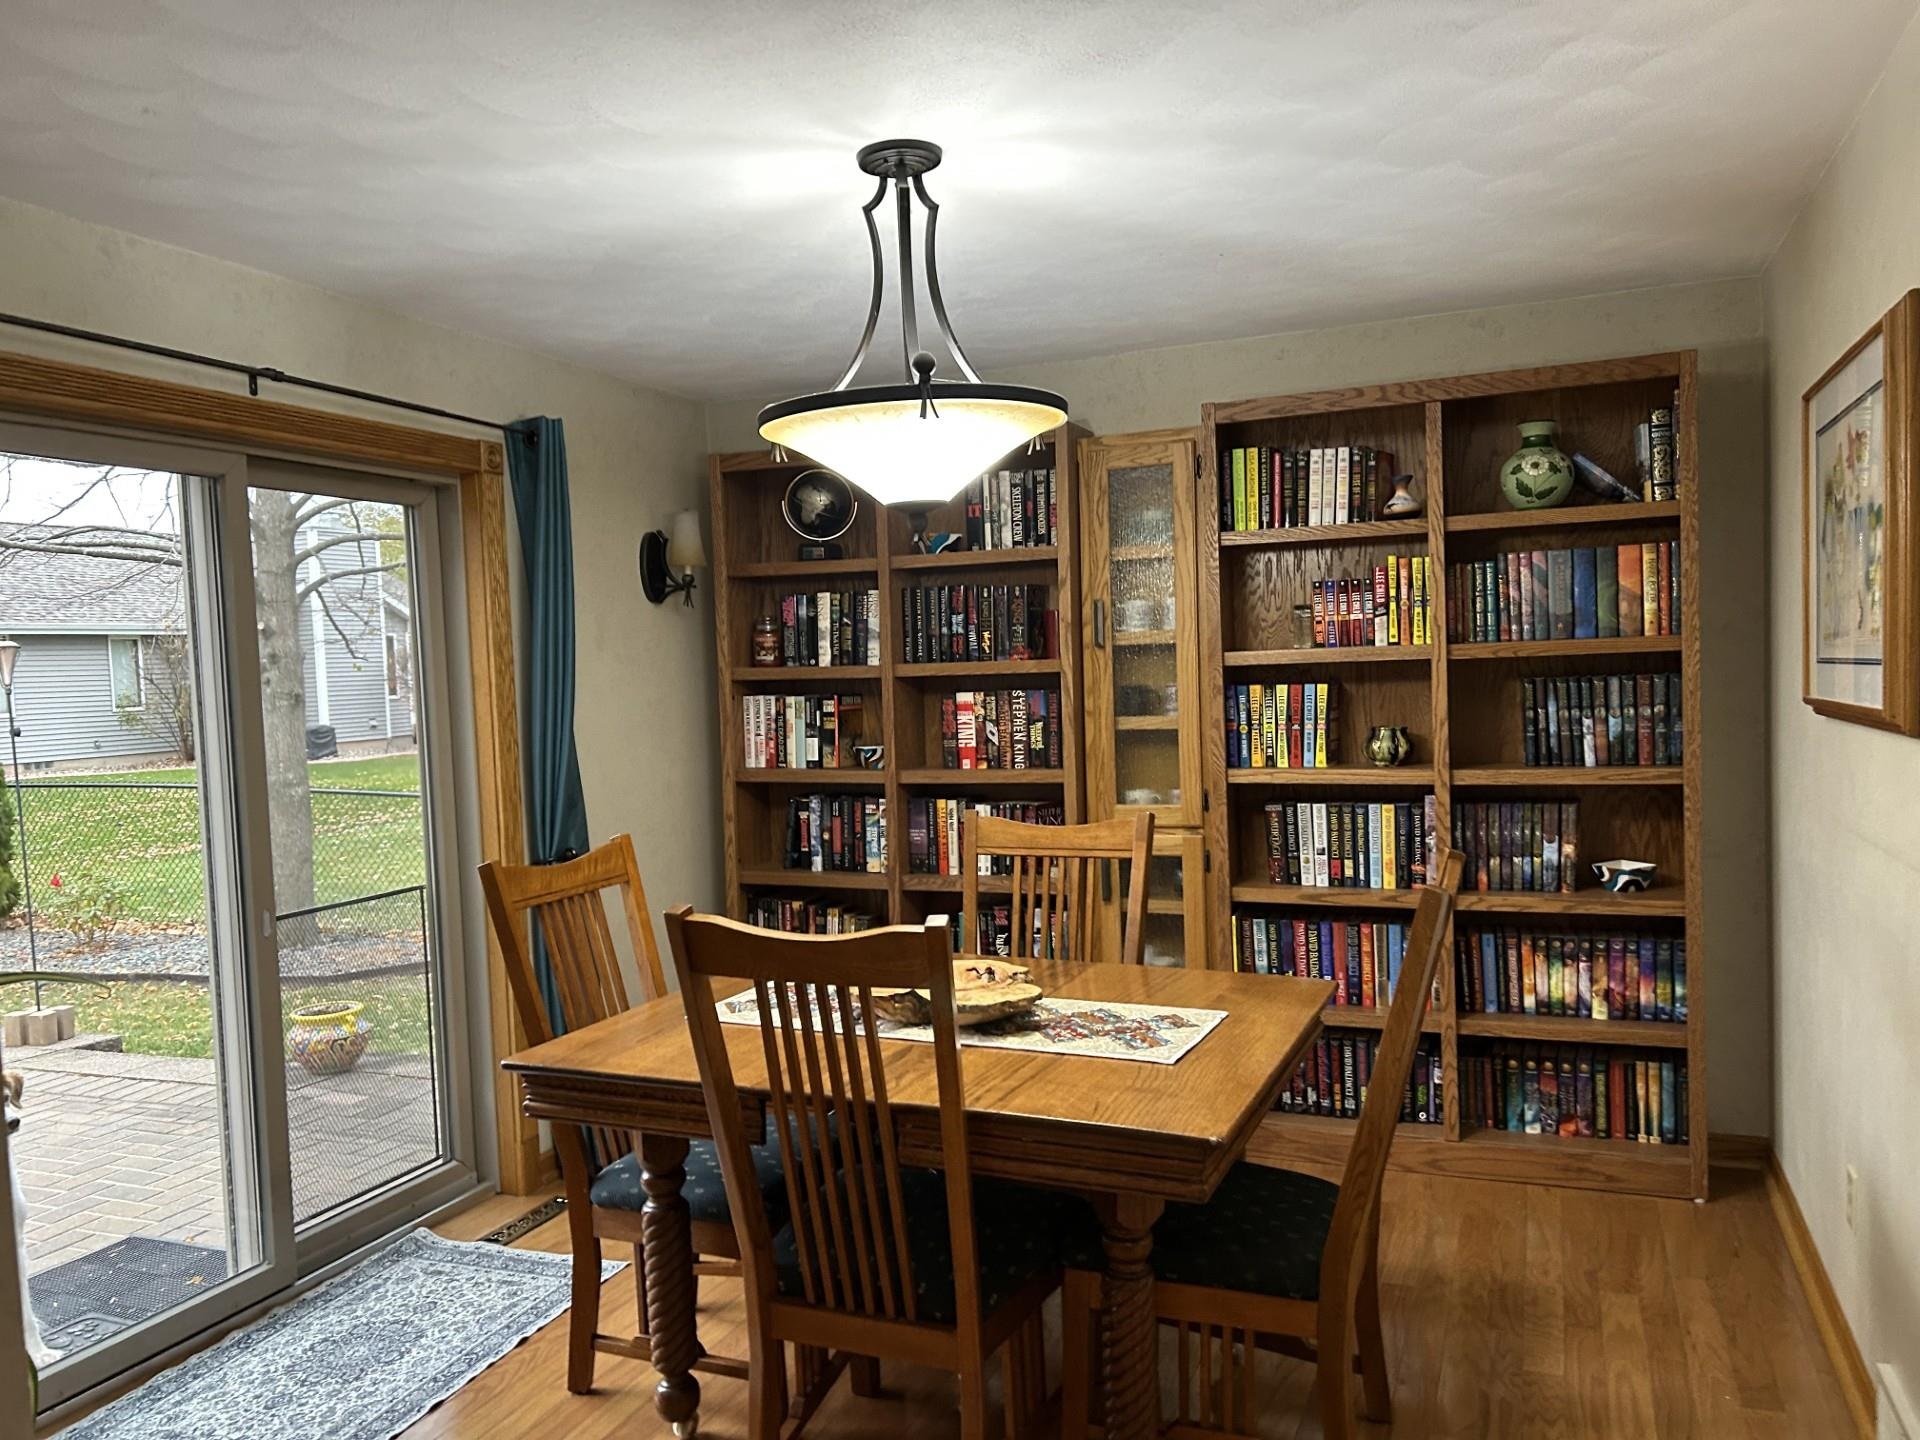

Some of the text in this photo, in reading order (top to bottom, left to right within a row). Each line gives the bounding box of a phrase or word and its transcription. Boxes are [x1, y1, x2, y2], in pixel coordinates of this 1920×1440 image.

[1012, 487, 1023, 542] SKELETON CREW
[1315, 594, 1323, 602] LEE
[1339, 593, 1347, 602] LEE
[1352, 592, 1360, 601] LEE
[1365, 591, 1373, 601] LEE
[1376, 571, 1386, 603] LEE CHILD
[1648, 559, 1656, 603] HARRY POTTER
[957, 716, 977, 748] KING
[1012, 690, 1025, 769] STEPHEN KING
[1035, 721, 1045, 750] NEEDFUL
[1267, 748, 1273, 756] ME
[1270, 817, 1281, 859] MURTAGH
[1286, 806, 1297, 851] DAVID BALDACCI
[1300, 805, 1310, 856] DAVID BALDACCI
[1330, 813, 1339, 830] DAVID
[1344, 813, 1353, 858] DAVID BALDACCI
[1371, 806, 1380, 854] DAVID BALDACCI
[1331, 831, 1340, 858] BALDACCI
[1242, 921, 1252, 965] DAVID BALDACCI
[1269, 924, 1278, 967] DAVID BALDACCI
[1296, 923, 1307, 977] DAVID BALDACC
[1308, 930, 1319, 979] DAVID BALDAC
[1348, 926, 1359, 976] DAVID BALDACCI
[1344, 1046, 1354, 1096] DAVID BALDACCI
